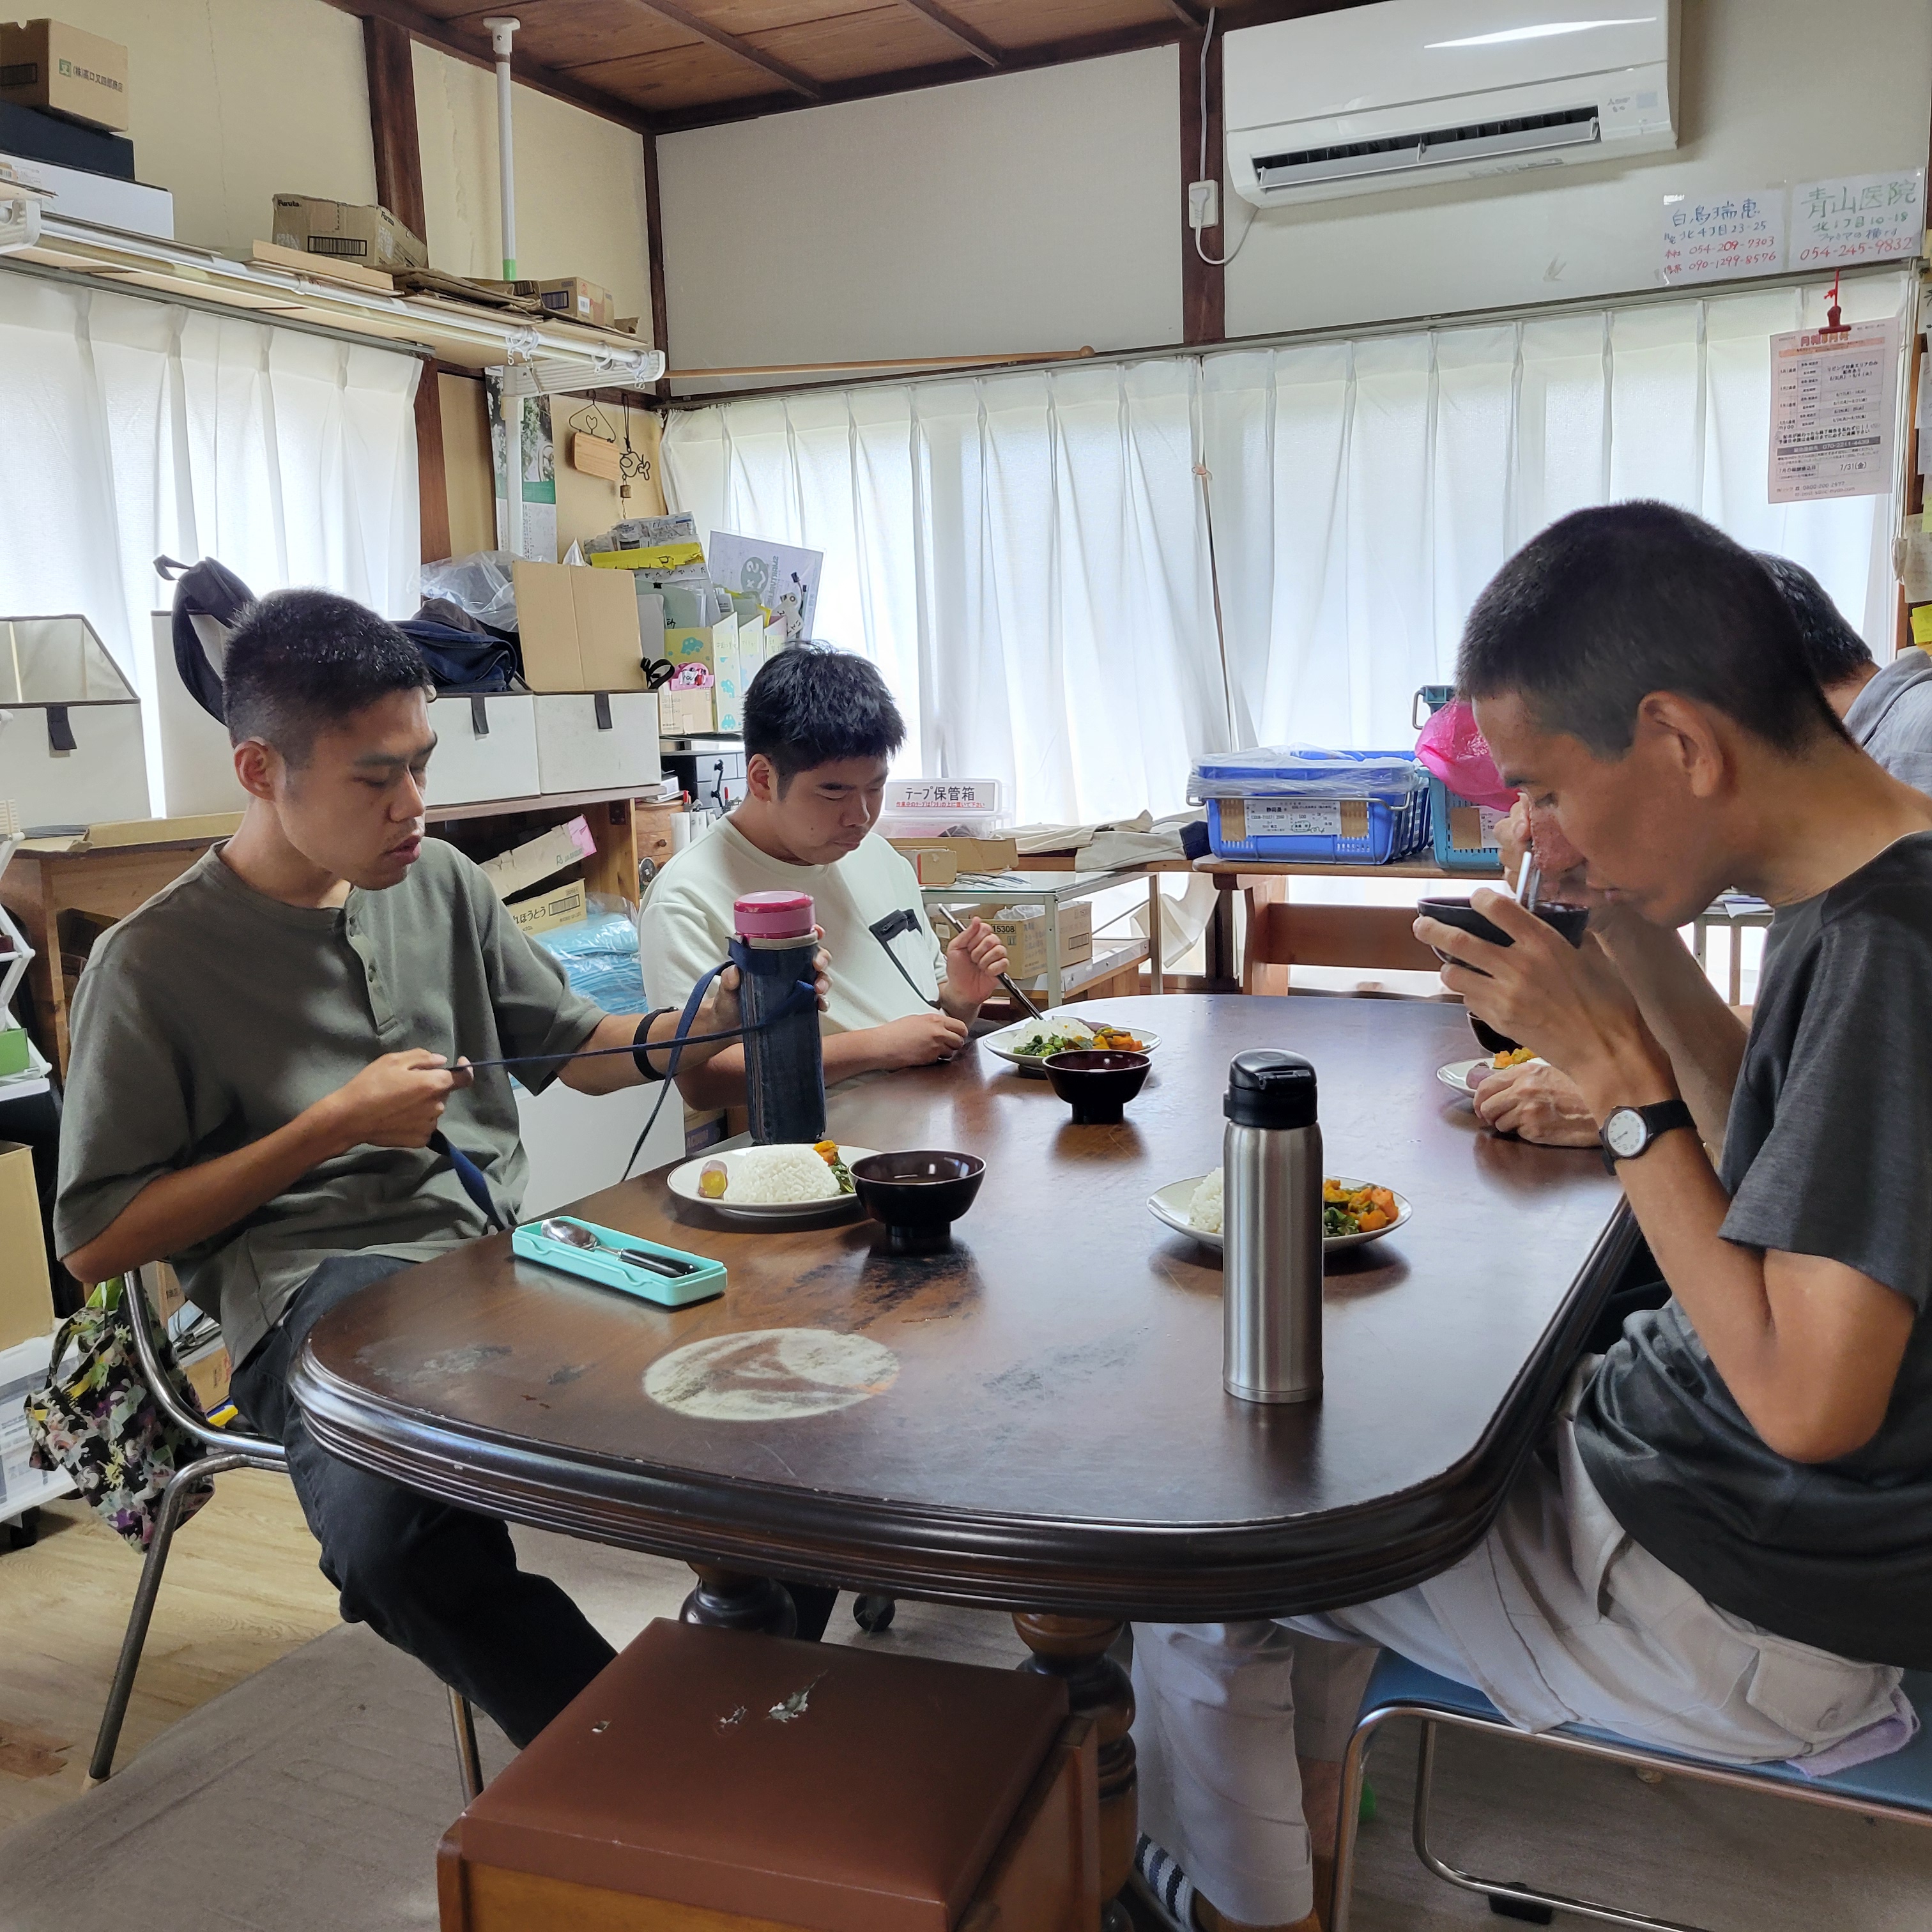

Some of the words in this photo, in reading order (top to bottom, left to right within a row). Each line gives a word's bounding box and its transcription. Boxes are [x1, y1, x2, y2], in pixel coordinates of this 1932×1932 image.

[1801, 179, 1917, 218] 青山医院
[1689, 236, 1775, 255] 054-209-7303
[1800, 236, 1913, 261] 054-245-9832
[1689, 251, 1776, 271] 090-1299-8576
[905, 786, 975, 801] テープ保管箱
